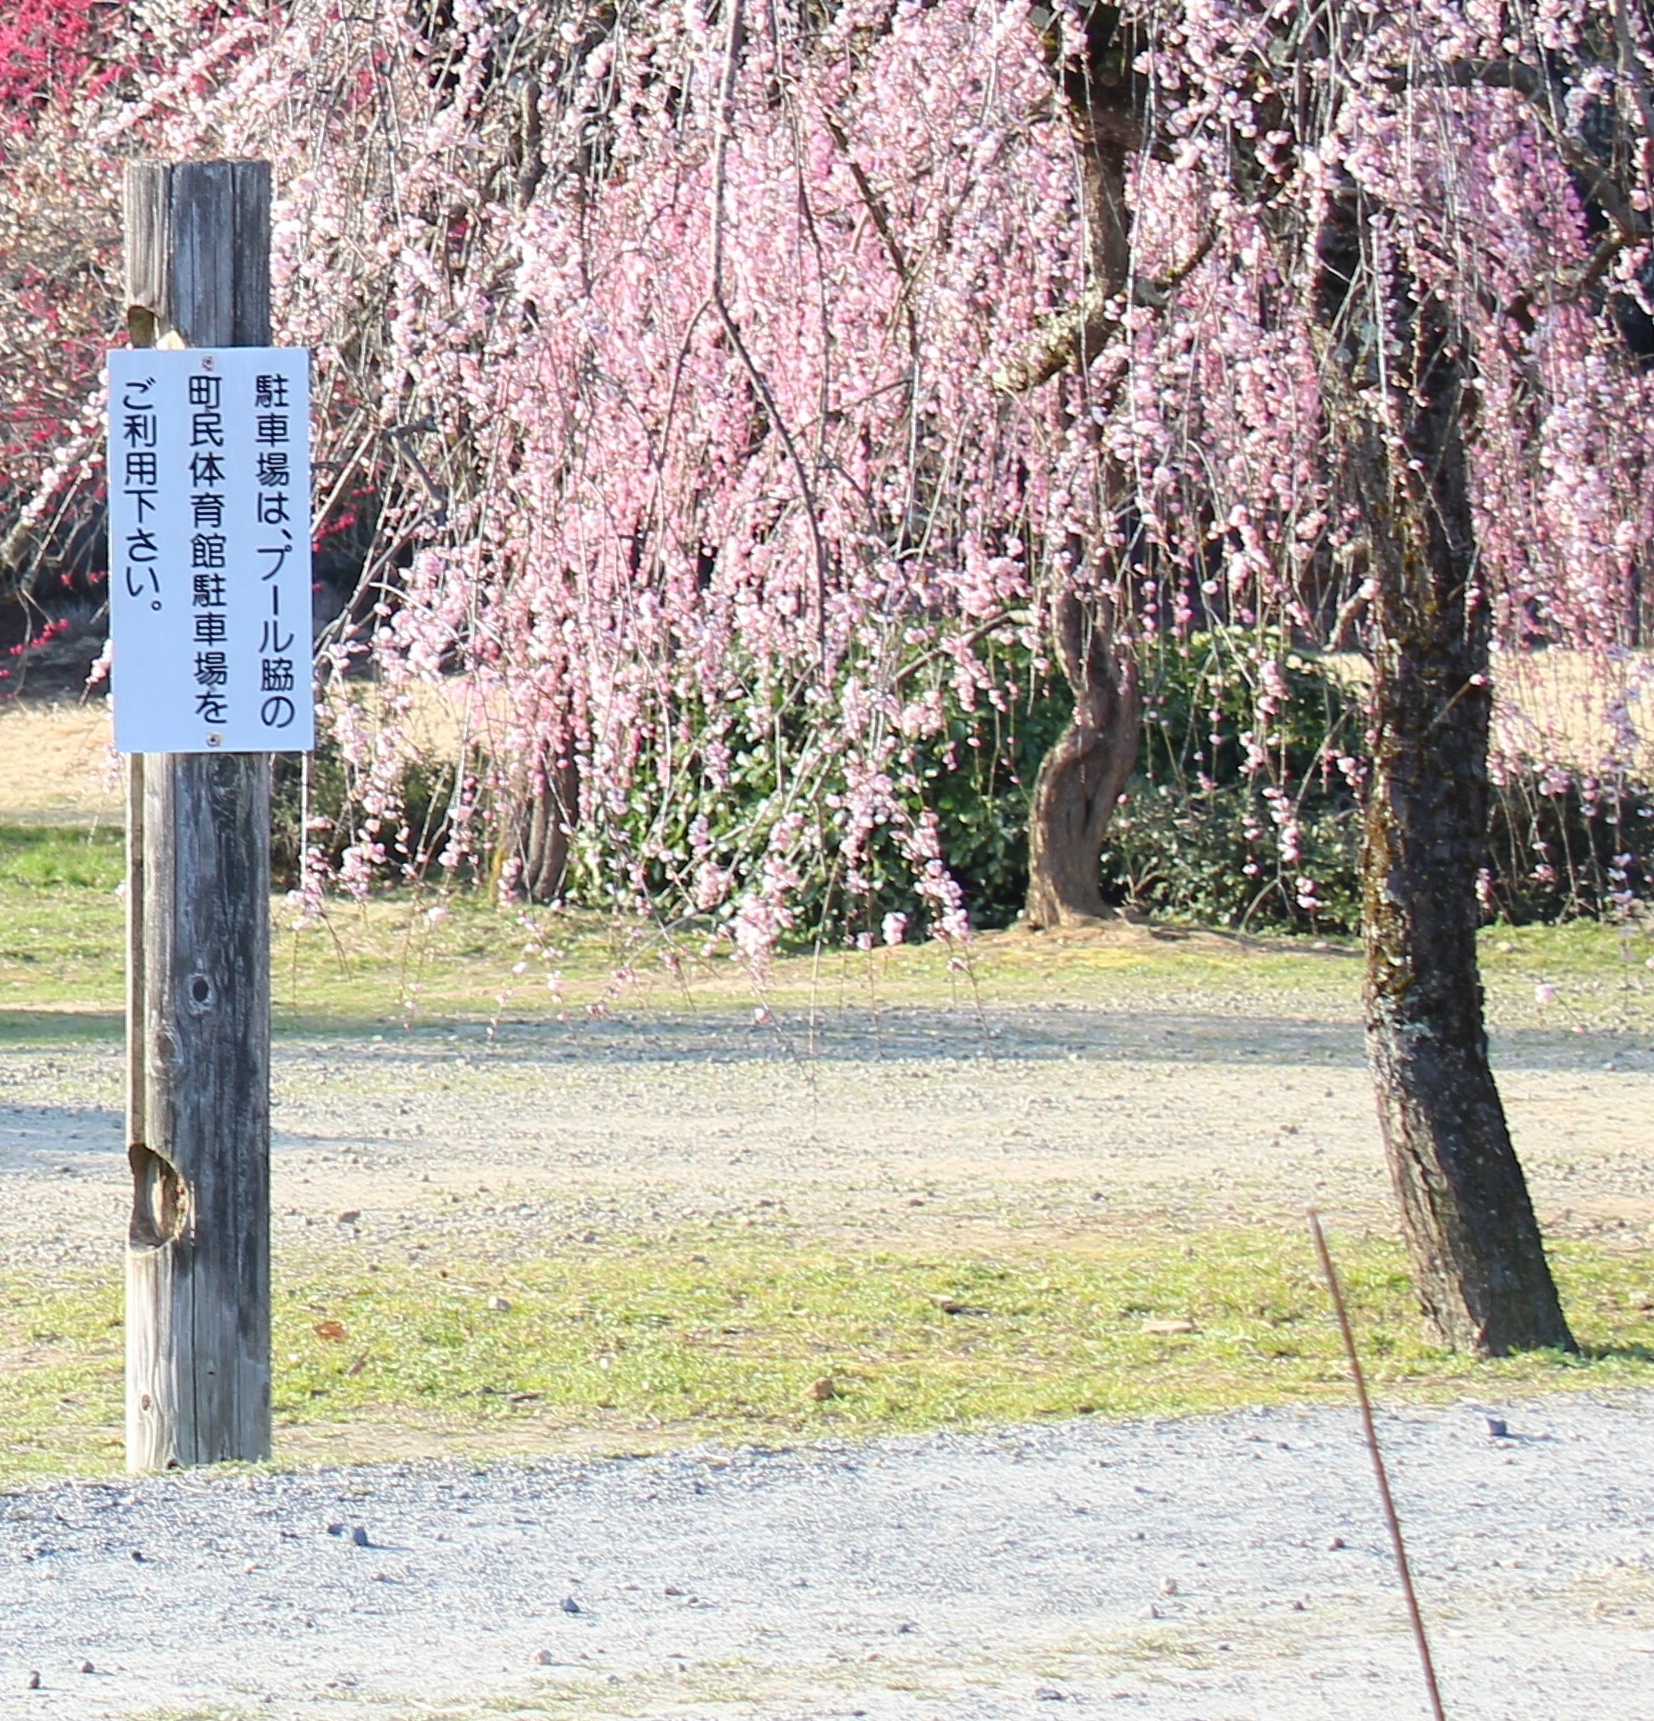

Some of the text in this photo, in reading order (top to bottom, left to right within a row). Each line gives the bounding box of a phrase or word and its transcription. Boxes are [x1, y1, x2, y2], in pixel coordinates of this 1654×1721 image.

[122, 377, 162, 612] ご利用下さい。
[188, 375, 229, 725] 町民体育館駐車場を
[255, 373, 295, 729] 駐車場は、プール脇の
